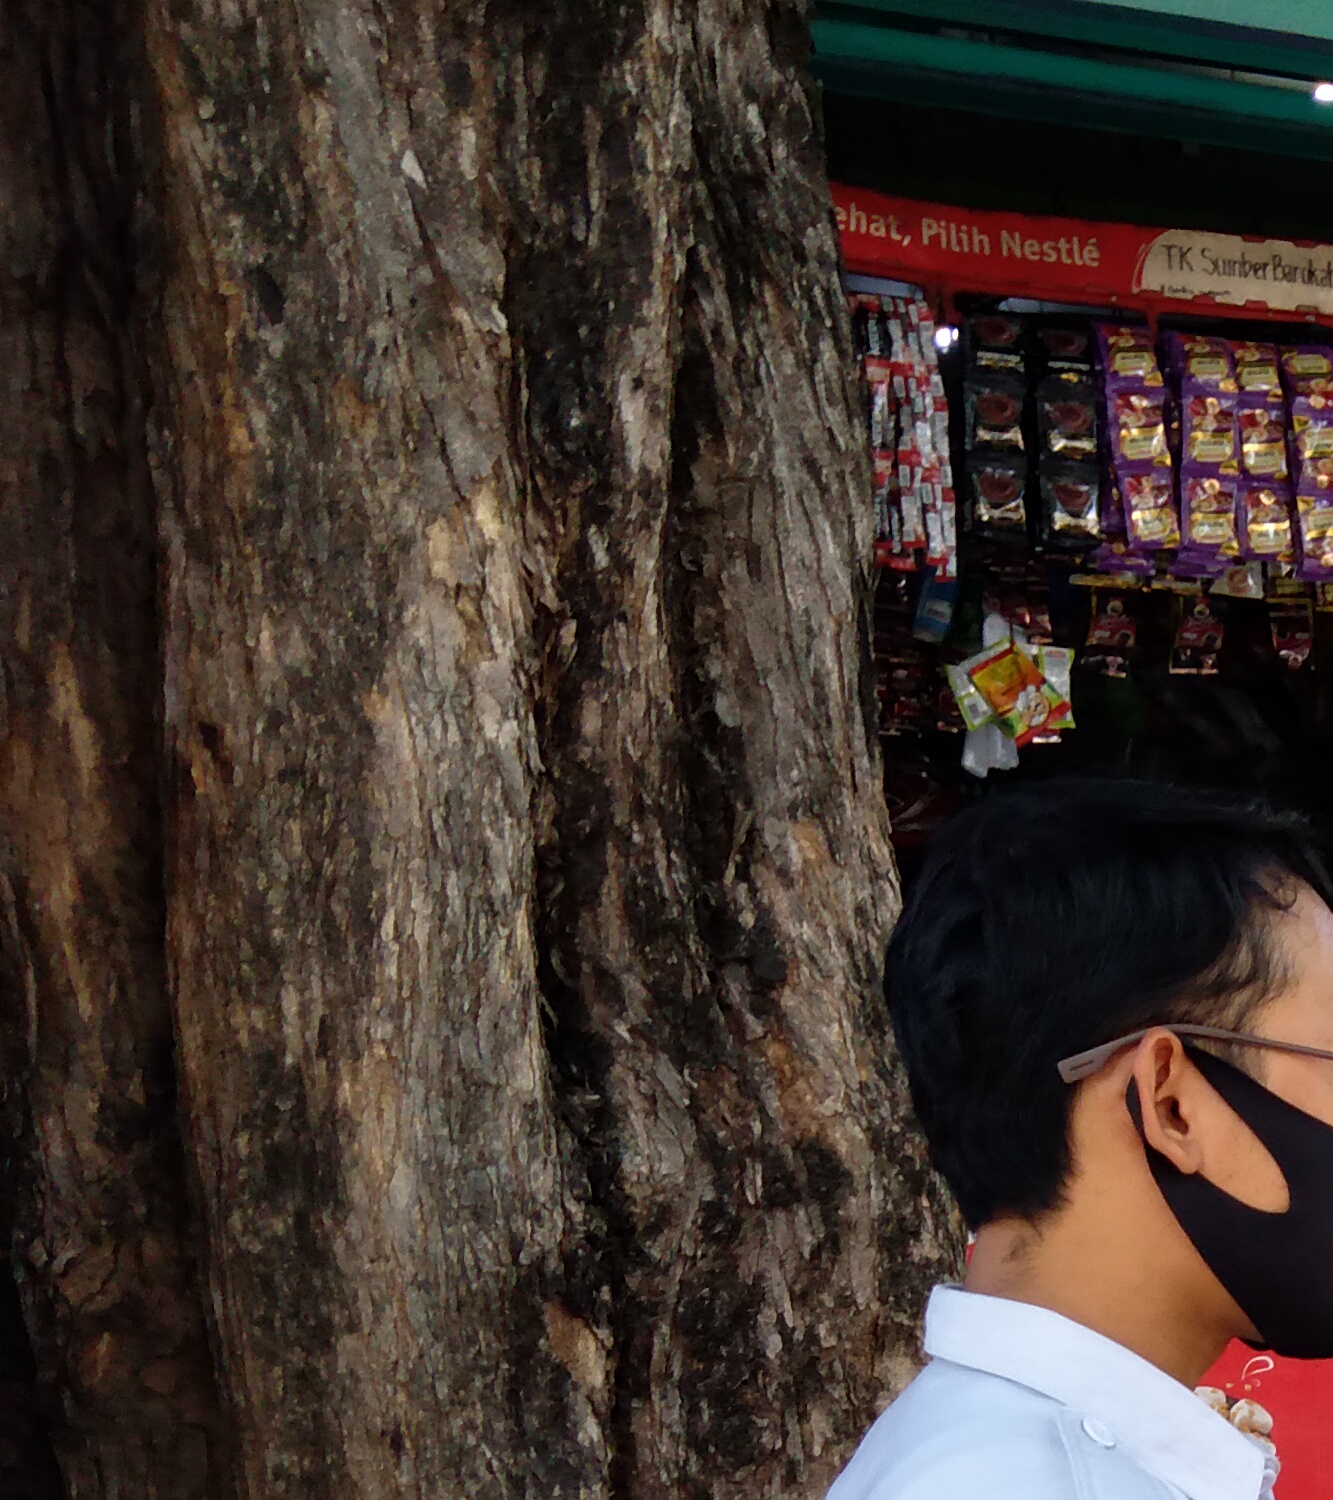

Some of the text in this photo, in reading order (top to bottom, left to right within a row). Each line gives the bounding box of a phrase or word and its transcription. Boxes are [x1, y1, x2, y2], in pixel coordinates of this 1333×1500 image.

[836, 203, 1100, 267] ehat, Pilih Nestlé
[1161, 243, 1194, 272] TK
